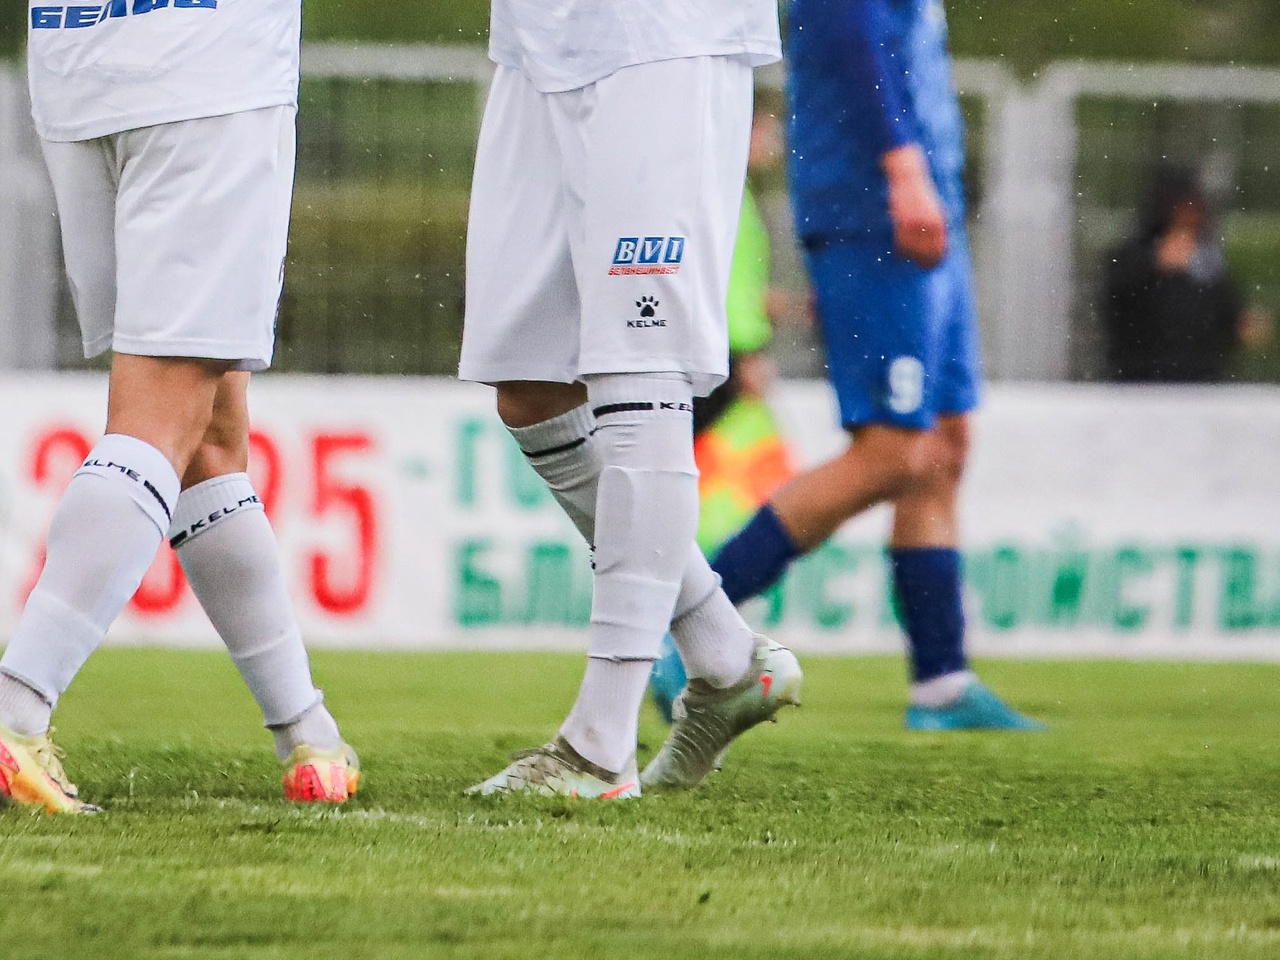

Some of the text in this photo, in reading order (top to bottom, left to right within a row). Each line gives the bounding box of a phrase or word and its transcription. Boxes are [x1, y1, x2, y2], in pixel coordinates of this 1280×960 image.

[613, 238, 683, 263] BVI
[627, 320, 667, 328] KELME
[84, 459, 141, 482] ELME
[23, 426, 380, 615] 25
[190, 495, 261, 533] KELME
